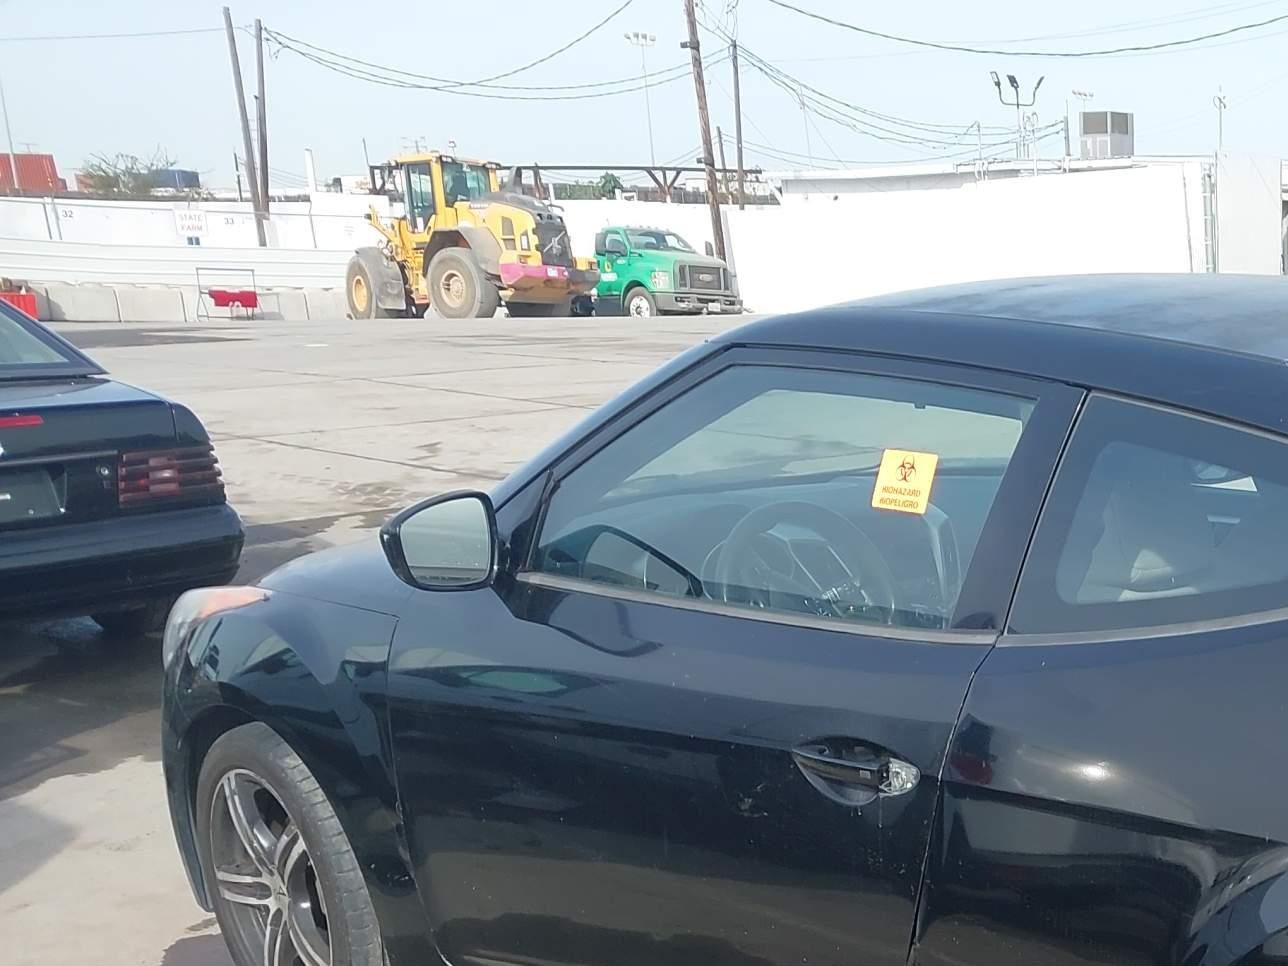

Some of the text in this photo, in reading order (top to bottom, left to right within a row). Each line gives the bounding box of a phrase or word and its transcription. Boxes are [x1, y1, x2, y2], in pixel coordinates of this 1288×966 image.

[62, 210, 73, 218] 32
[179, 213, 203, 223] STATE
[881, 486, 921, 497] BIOHAZARD
